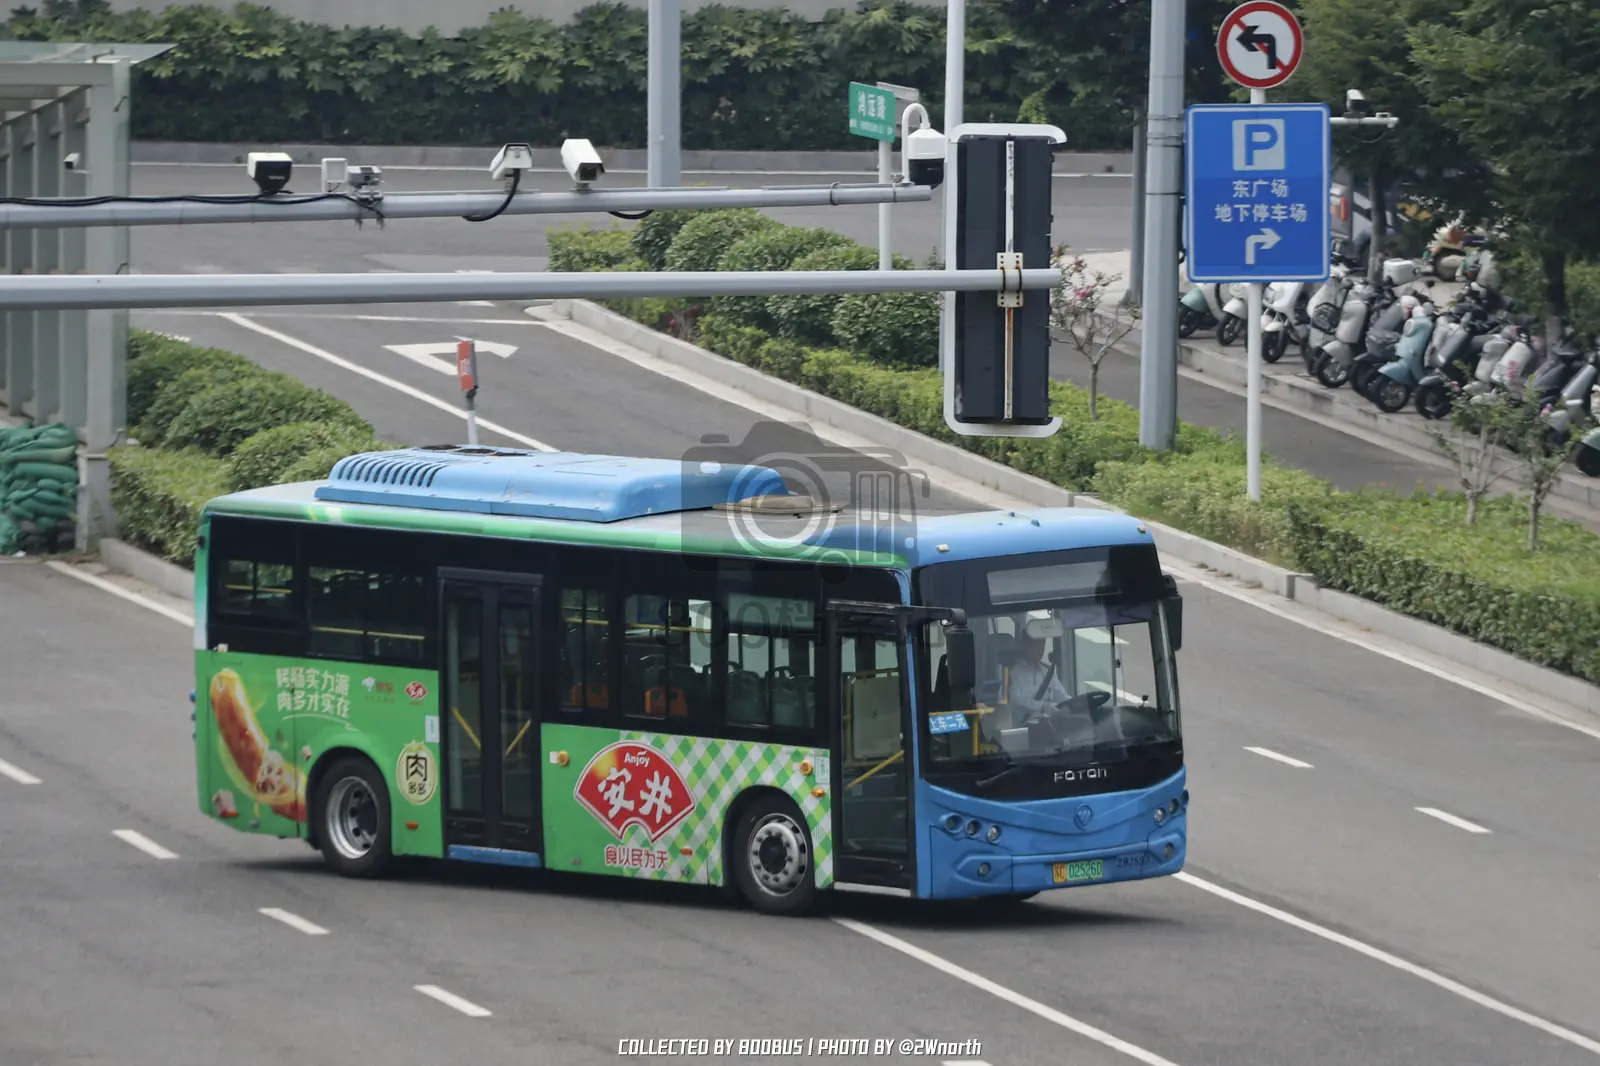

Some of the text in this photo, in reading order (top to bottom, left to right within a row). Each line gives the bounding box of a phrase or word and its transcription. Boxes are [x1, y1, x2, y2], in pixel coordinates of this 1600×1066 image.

[1244, 123, 1279, 166] P
[1232, 179, 1289, 198] 东广场
[1214, 203, 1308, 223] 地下停车场
[624, 750, 650, 767] Anjoy
[597, 767, 673, 824] 安井
[605, 845, 668, 869] 食以民为天
